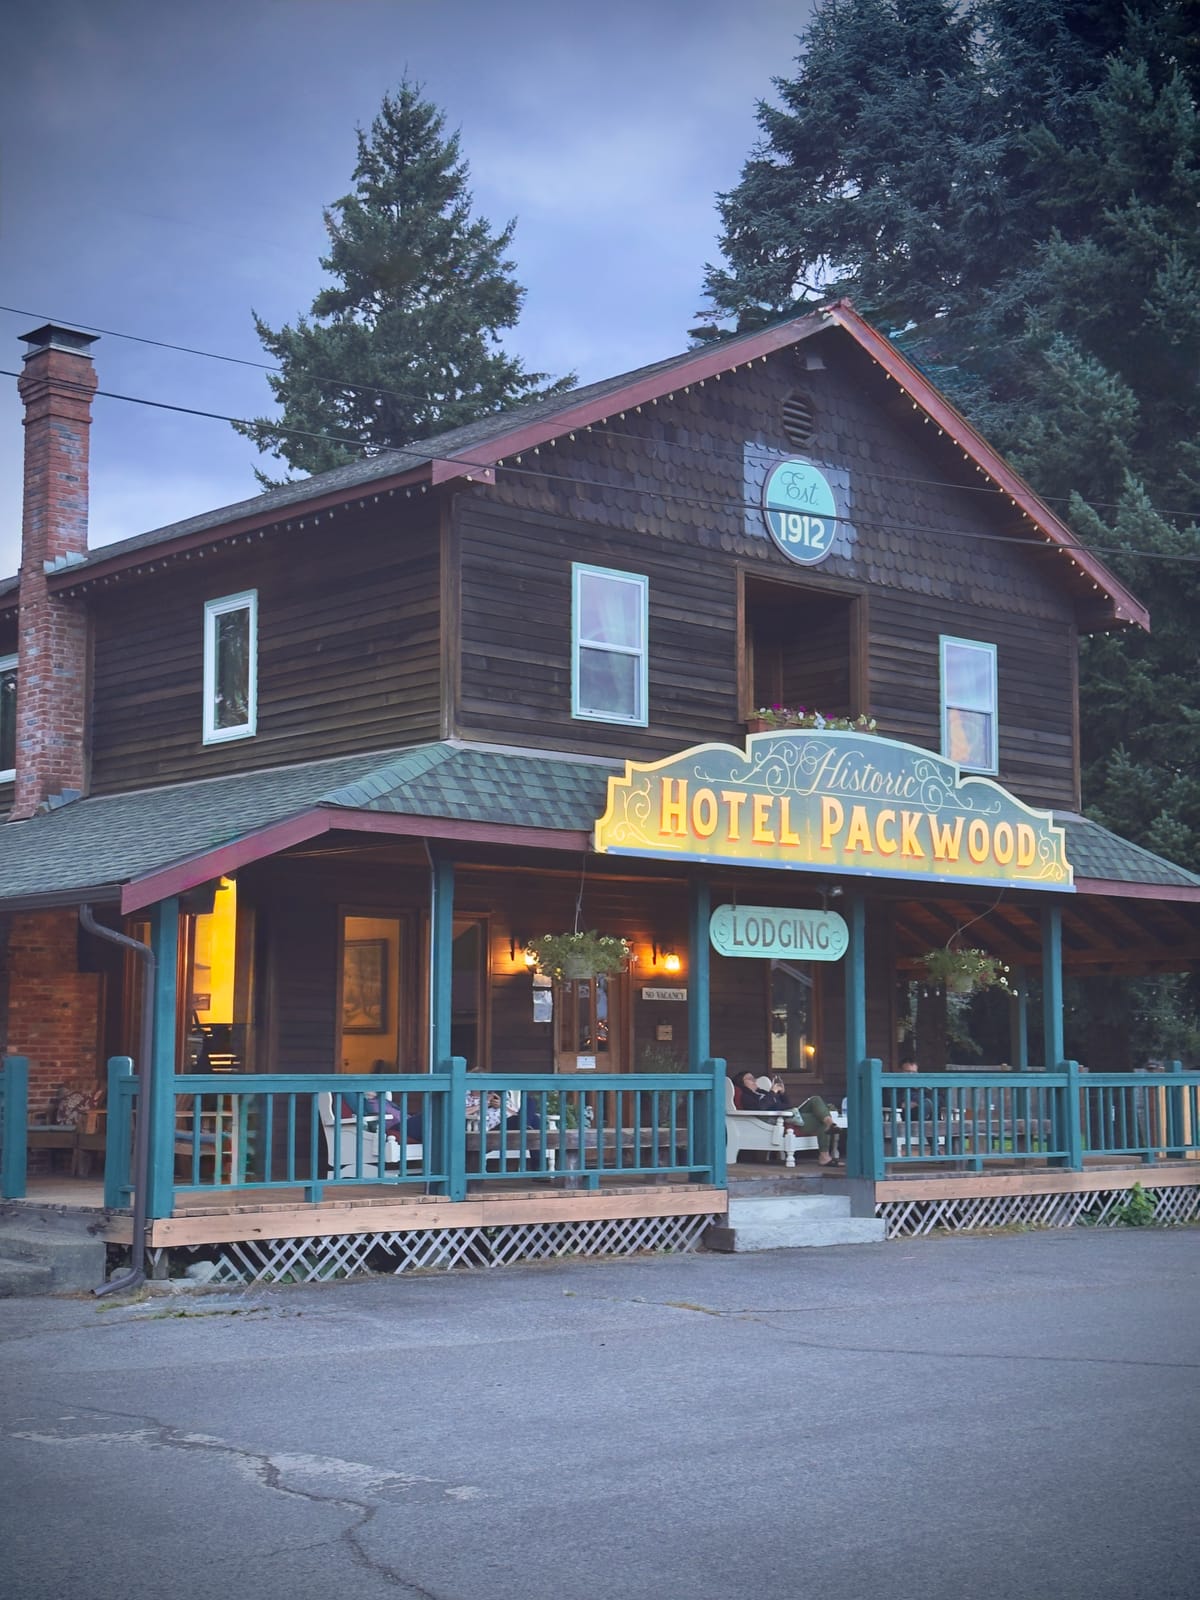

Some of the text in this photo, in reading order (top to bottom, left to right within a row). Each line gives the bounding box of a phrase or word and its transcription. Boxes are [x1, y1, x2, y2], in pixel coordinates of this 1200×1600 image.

[779, 512, 825, 550] 1912
[796, 741, 918, 798] Historic
[659, 777, 1037, 868] HOTEL PACKWOOD
[733, 914, 830, 951] LODGING
[645, 991, 685, 1000] NO VACANCY
